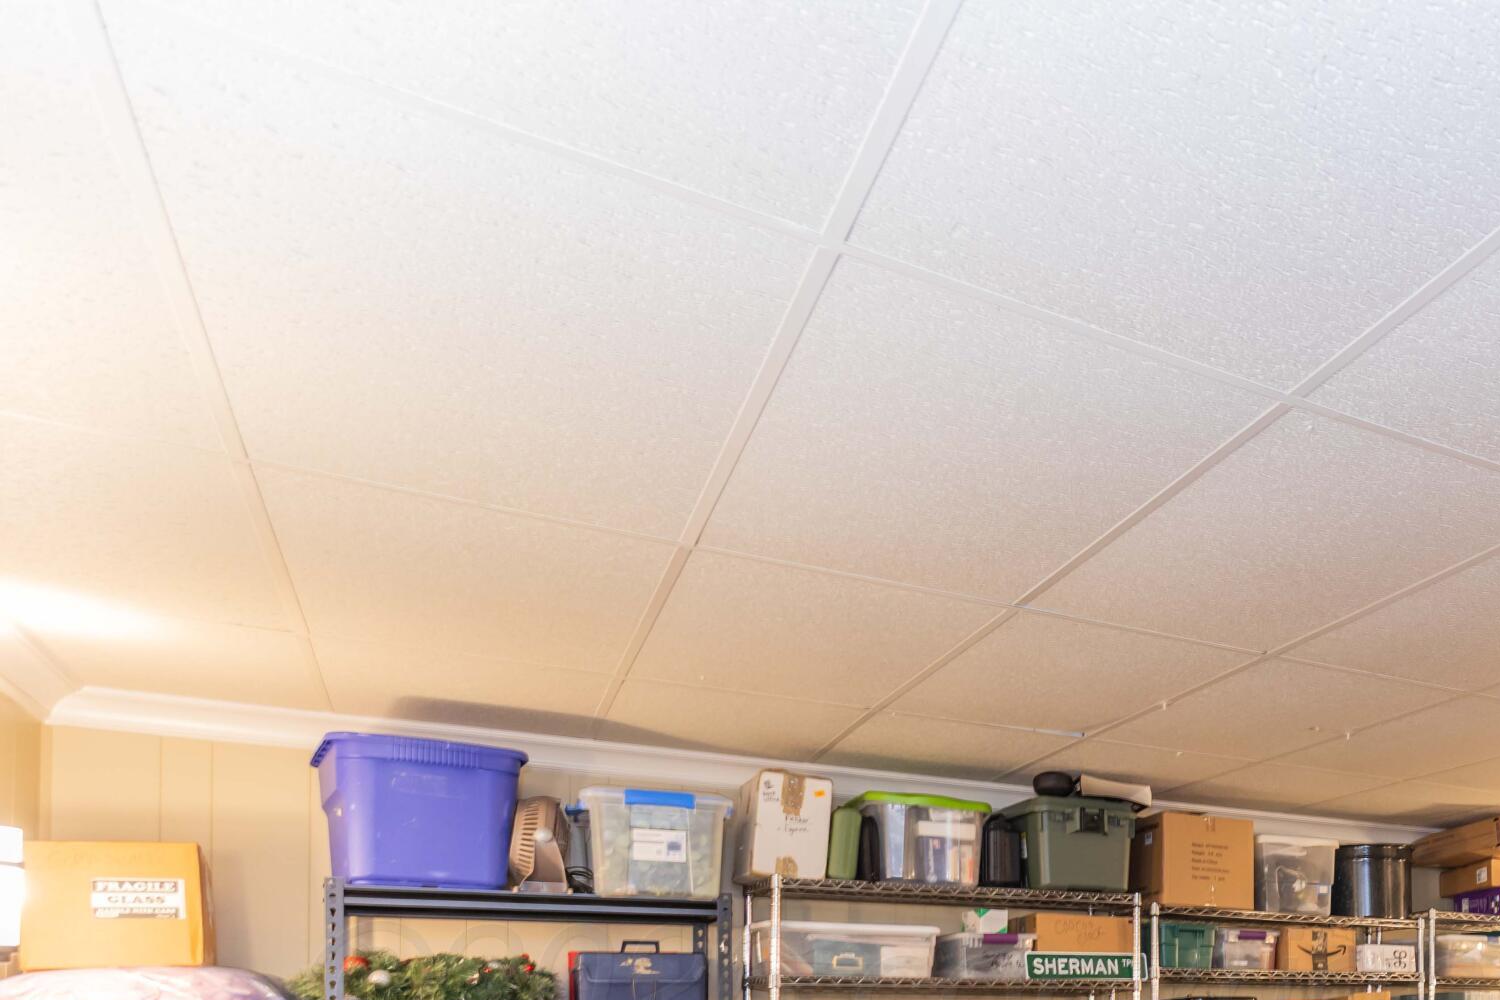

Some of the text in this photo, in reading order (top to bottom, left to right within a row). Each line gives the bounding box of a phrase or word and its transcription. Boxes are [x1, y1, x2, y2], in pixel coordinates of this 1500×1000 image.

[96, 881, 176, 892] FRAGILE
[107, 895, 166, 904] GLASS
[1033, 957, 1119, 976] SHERMAN
[1121, 958, 1134, 968] TP
